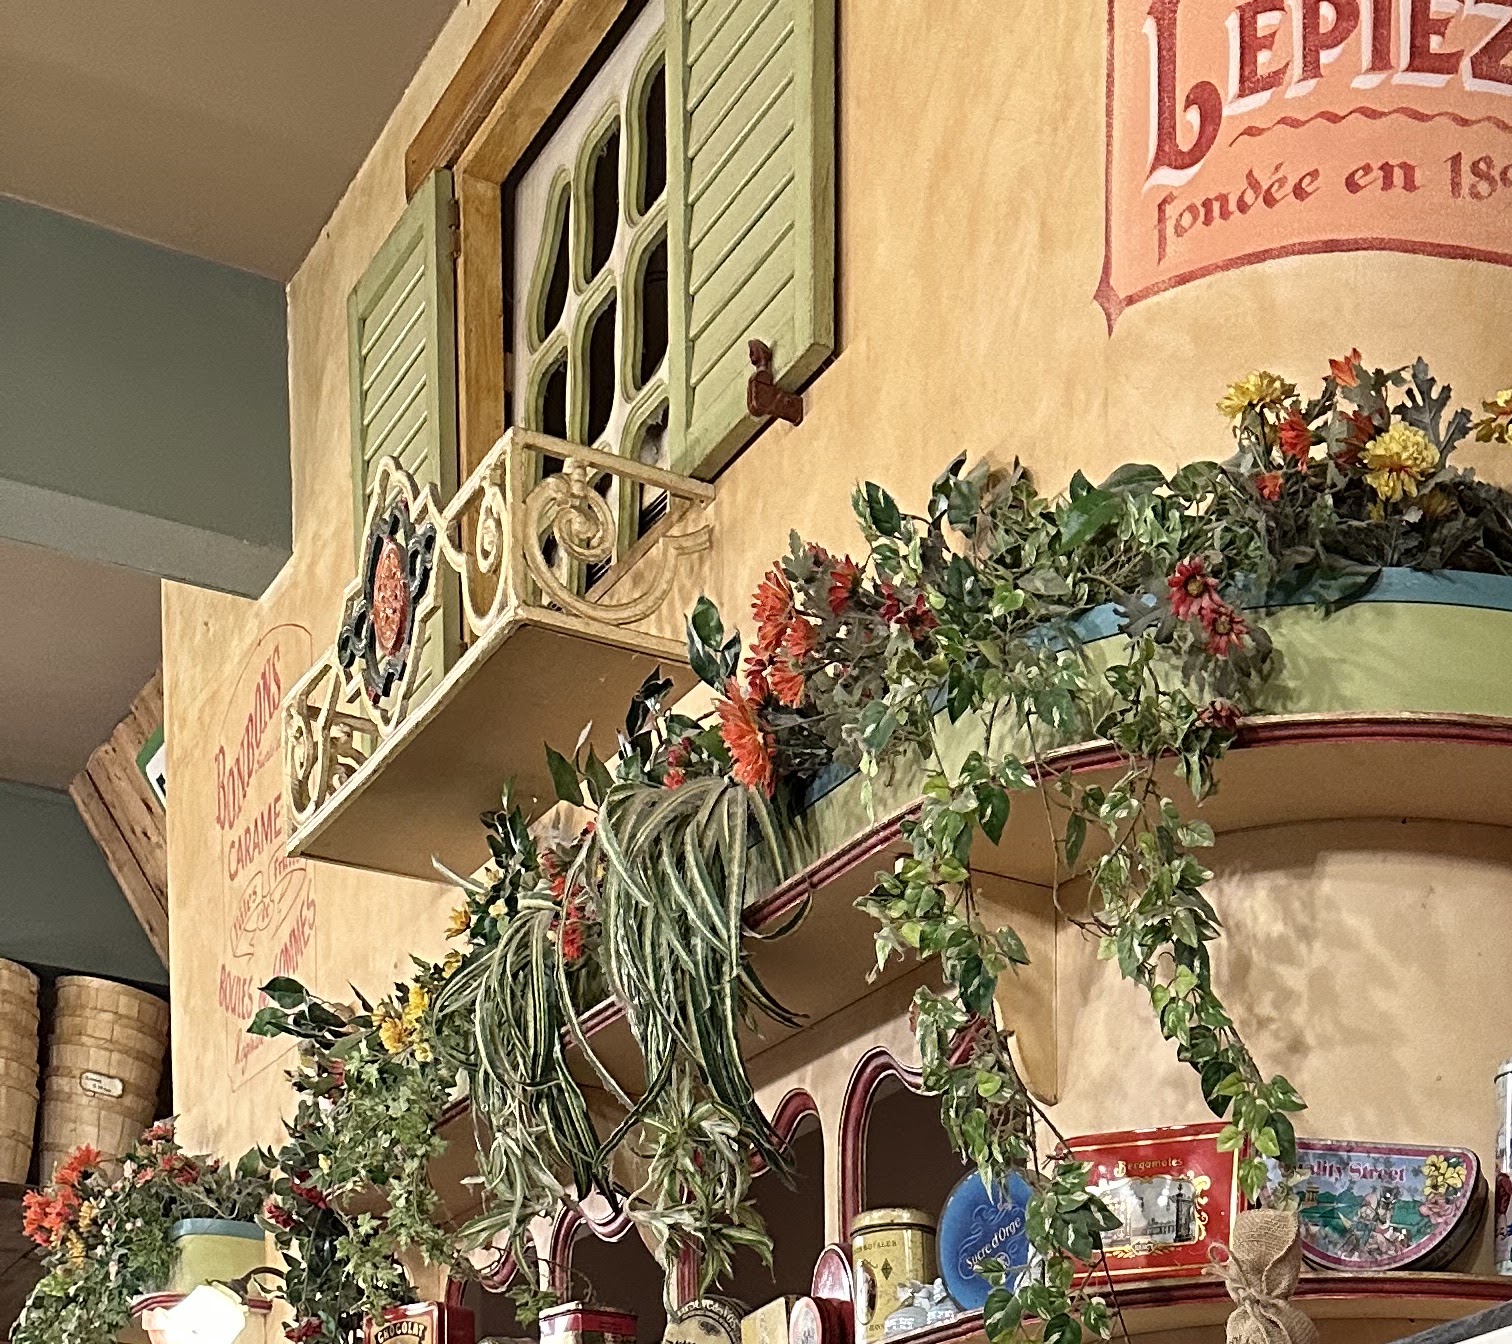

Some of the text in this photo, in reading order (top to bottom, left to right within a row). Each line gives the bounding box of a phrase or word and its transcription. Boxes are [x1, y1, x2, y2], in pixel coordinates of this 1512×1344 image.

[1153, 161, 1320, 265] fondée
[1345, 160, 1419, 196] en
[215, 643, 281, 830] BONBONS
[228, 792, 282, 881] CARAME
[1349, 1161, 1406, 1184] Street
[965, 1243, 992, 1271] Sucre
[376, 1321, 427, 1343] CHOCOLAT
